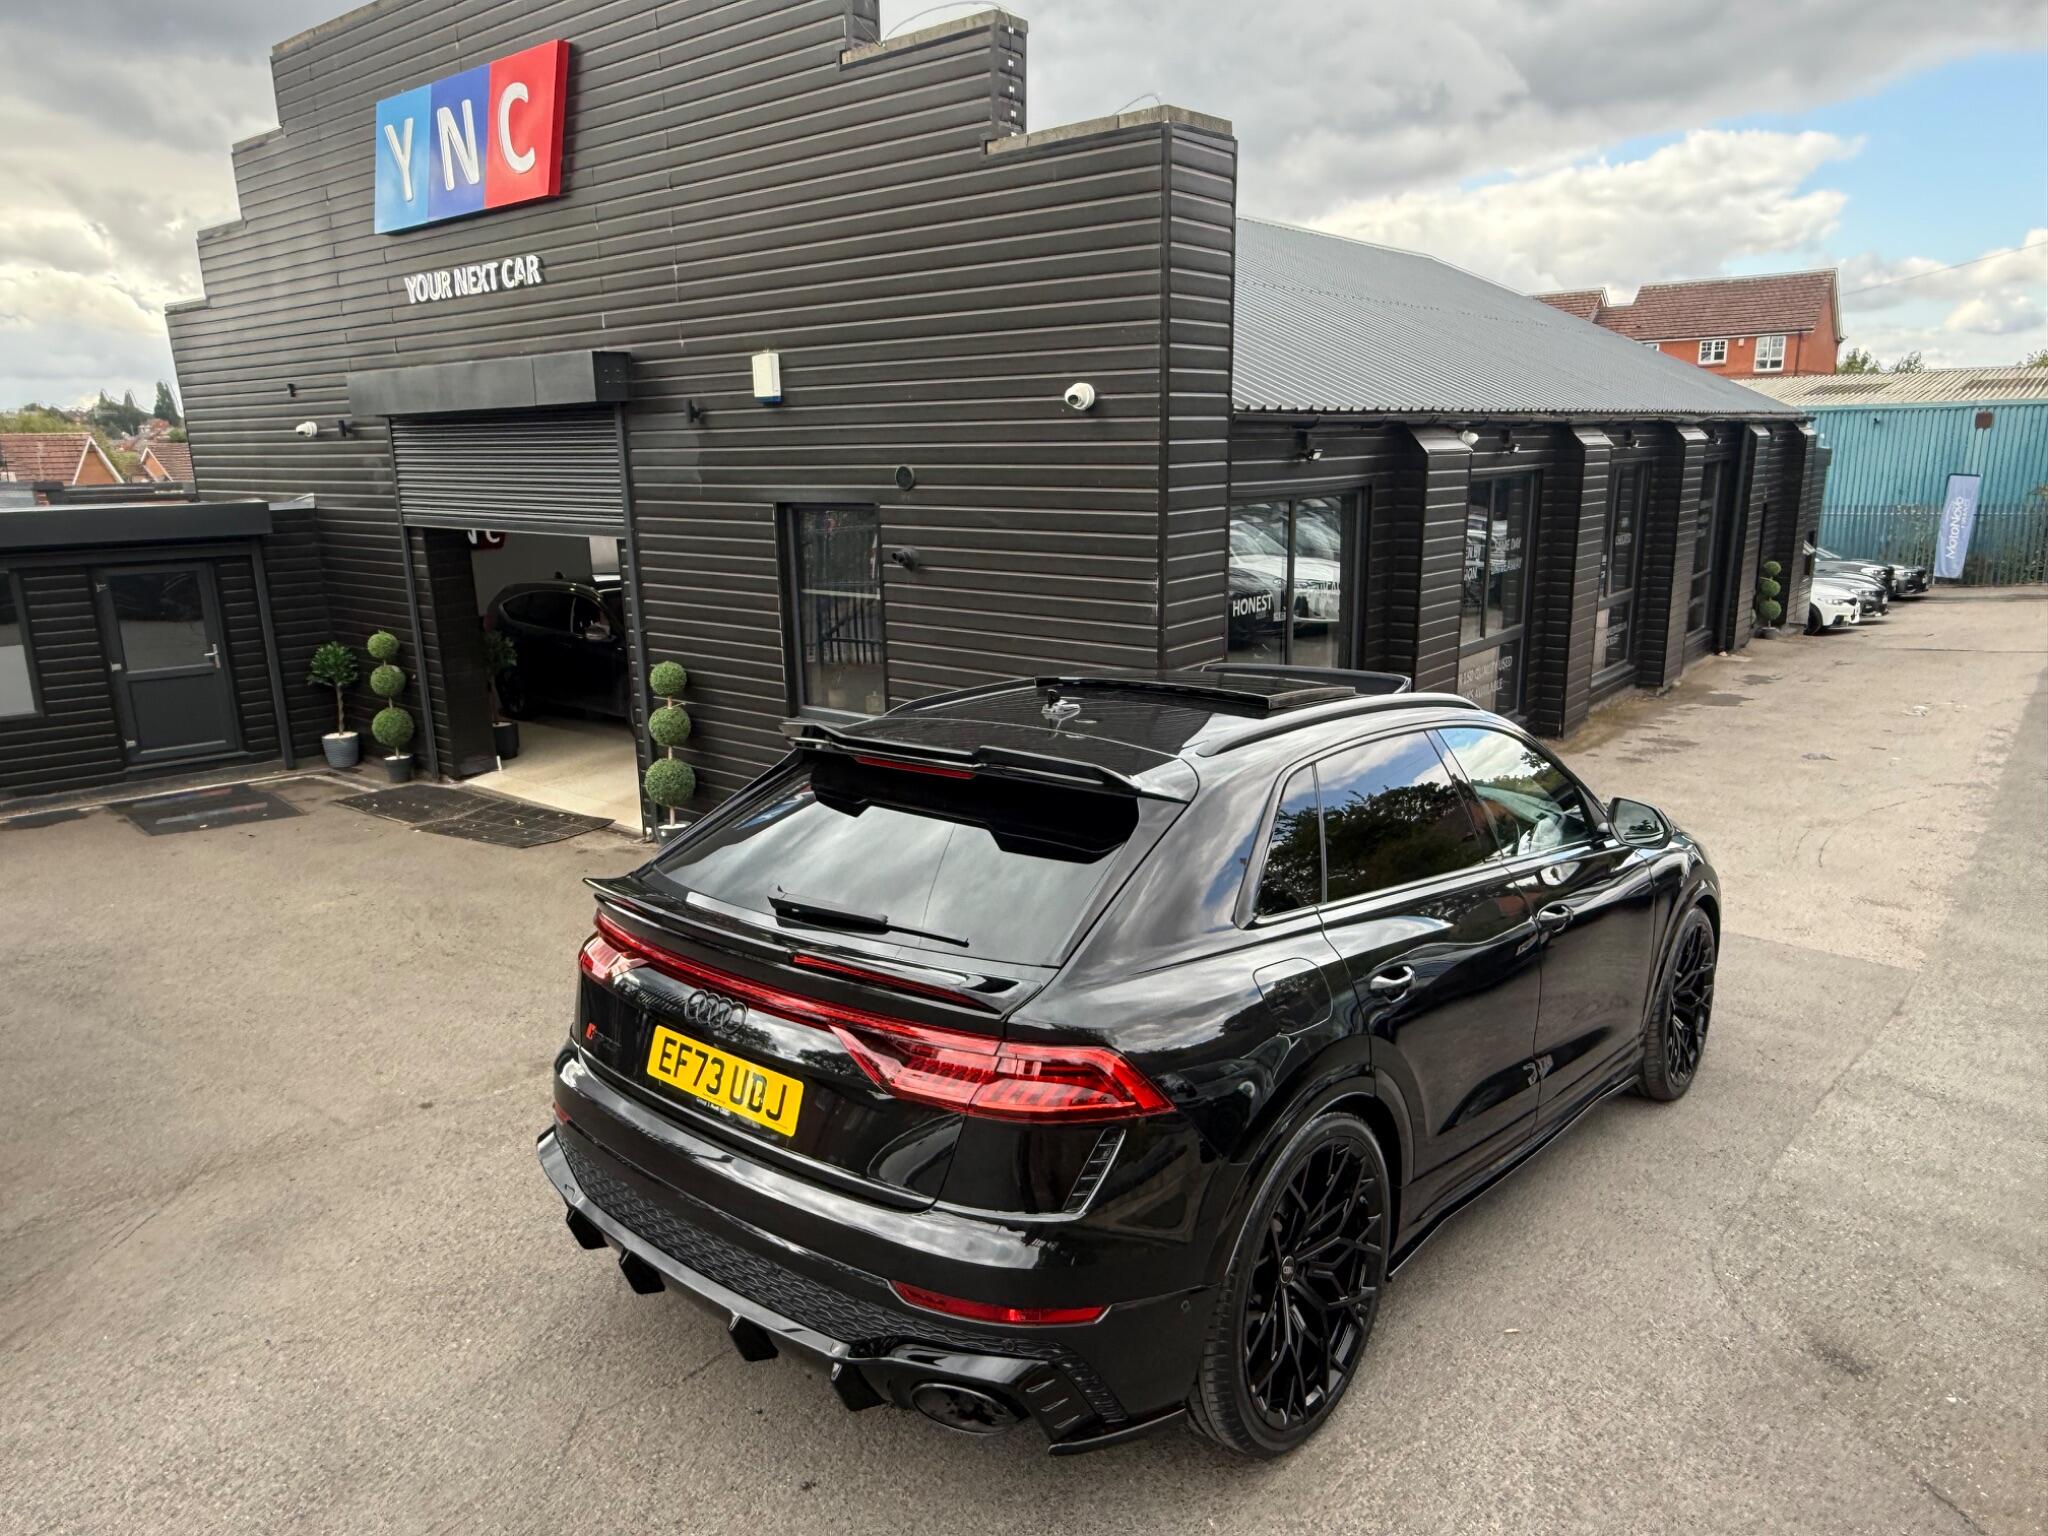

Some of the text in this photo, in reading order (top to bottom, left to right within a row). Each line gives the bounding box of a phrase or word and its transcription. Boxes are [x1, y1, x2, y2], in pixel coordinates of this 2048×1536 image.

[384, 82, 535, 201] YNC
[404, 255, 542, 304] YOUR NEXT CAR
[1232, 594, 1272, 617] HONEST
[658, 1036, 725, 1096] EF73
